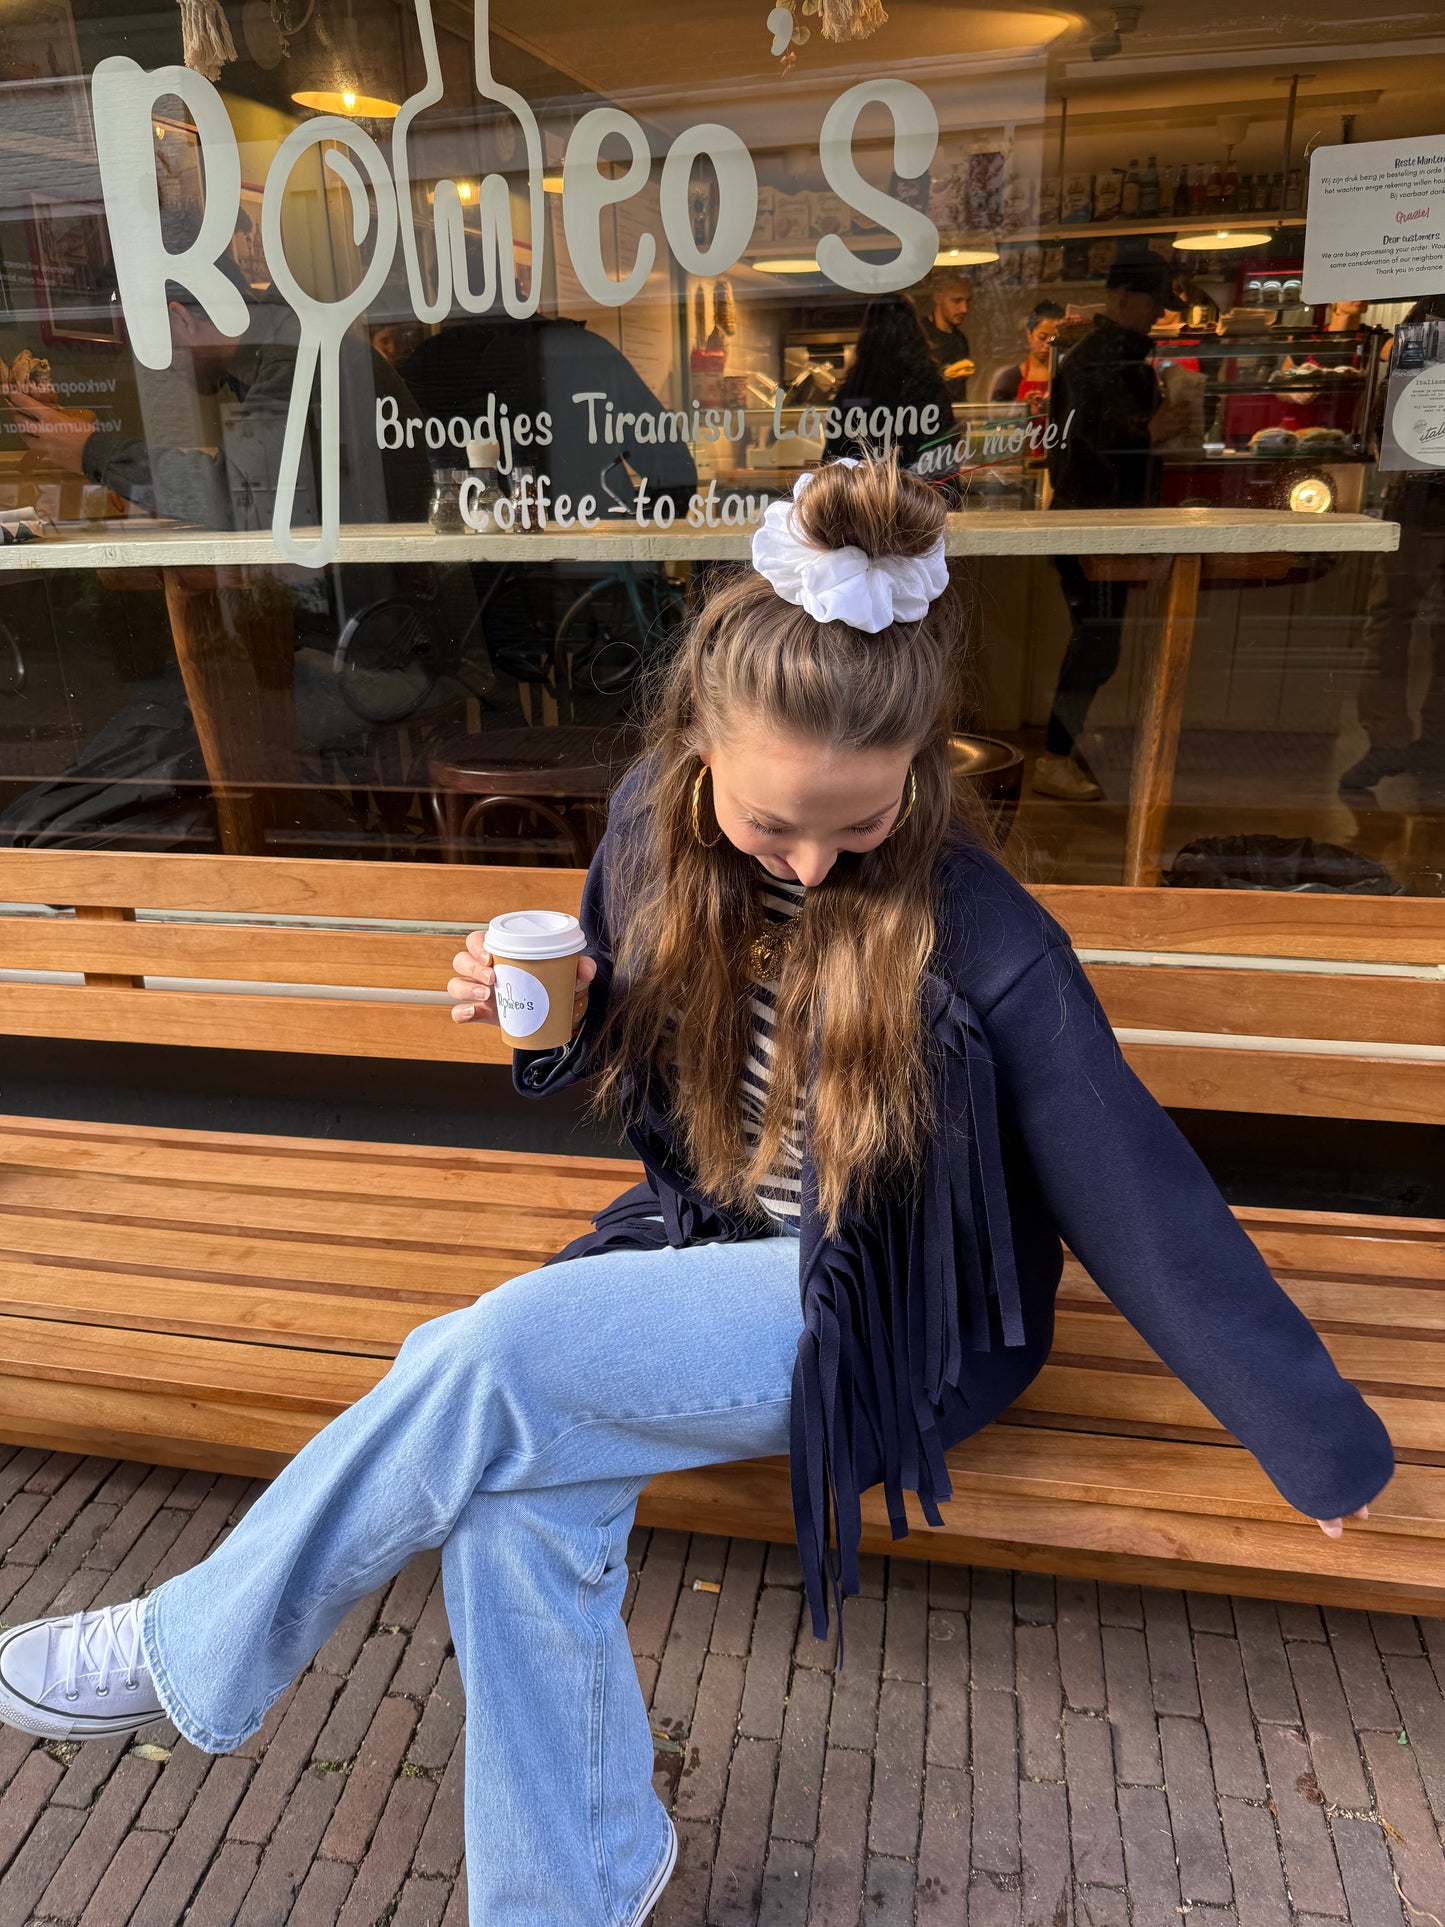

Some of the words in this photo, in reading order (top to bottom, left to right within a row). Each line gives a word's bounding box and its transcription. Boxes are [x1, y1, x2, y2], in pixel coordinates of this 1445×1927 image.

[1395, 158, 1416, 168] Beste
[1321, 177, 1331, 186] Wij
[1332, 176, 1344, 185] zijn
[1360, 174, 1378, 182] bezig
[1386, 170, 1418, 178] bestelling
[1400, 190, 1428, 198] voorbaat
[1396, 208, 1430, 224] Grazie!
[1383, 234, 1401, 245] Dear
[1360, 248, 1394, 257] processing
[1348, 259, 1390, 267] consideration
[1412, 254, 1443, 262] neighbors
[1395, 267, 1407, 275] you
[376, 393, 553, 475] Broodjes
[572, 391, 745, 445] Tiramisu
[773, 388, 941, 463] Lasagne
[917, 423, 975, 476] and
[983, 409, 1076, 457] more!
[459, 477, 601, 530] Coffee
[633, 477, 675, 529] to
